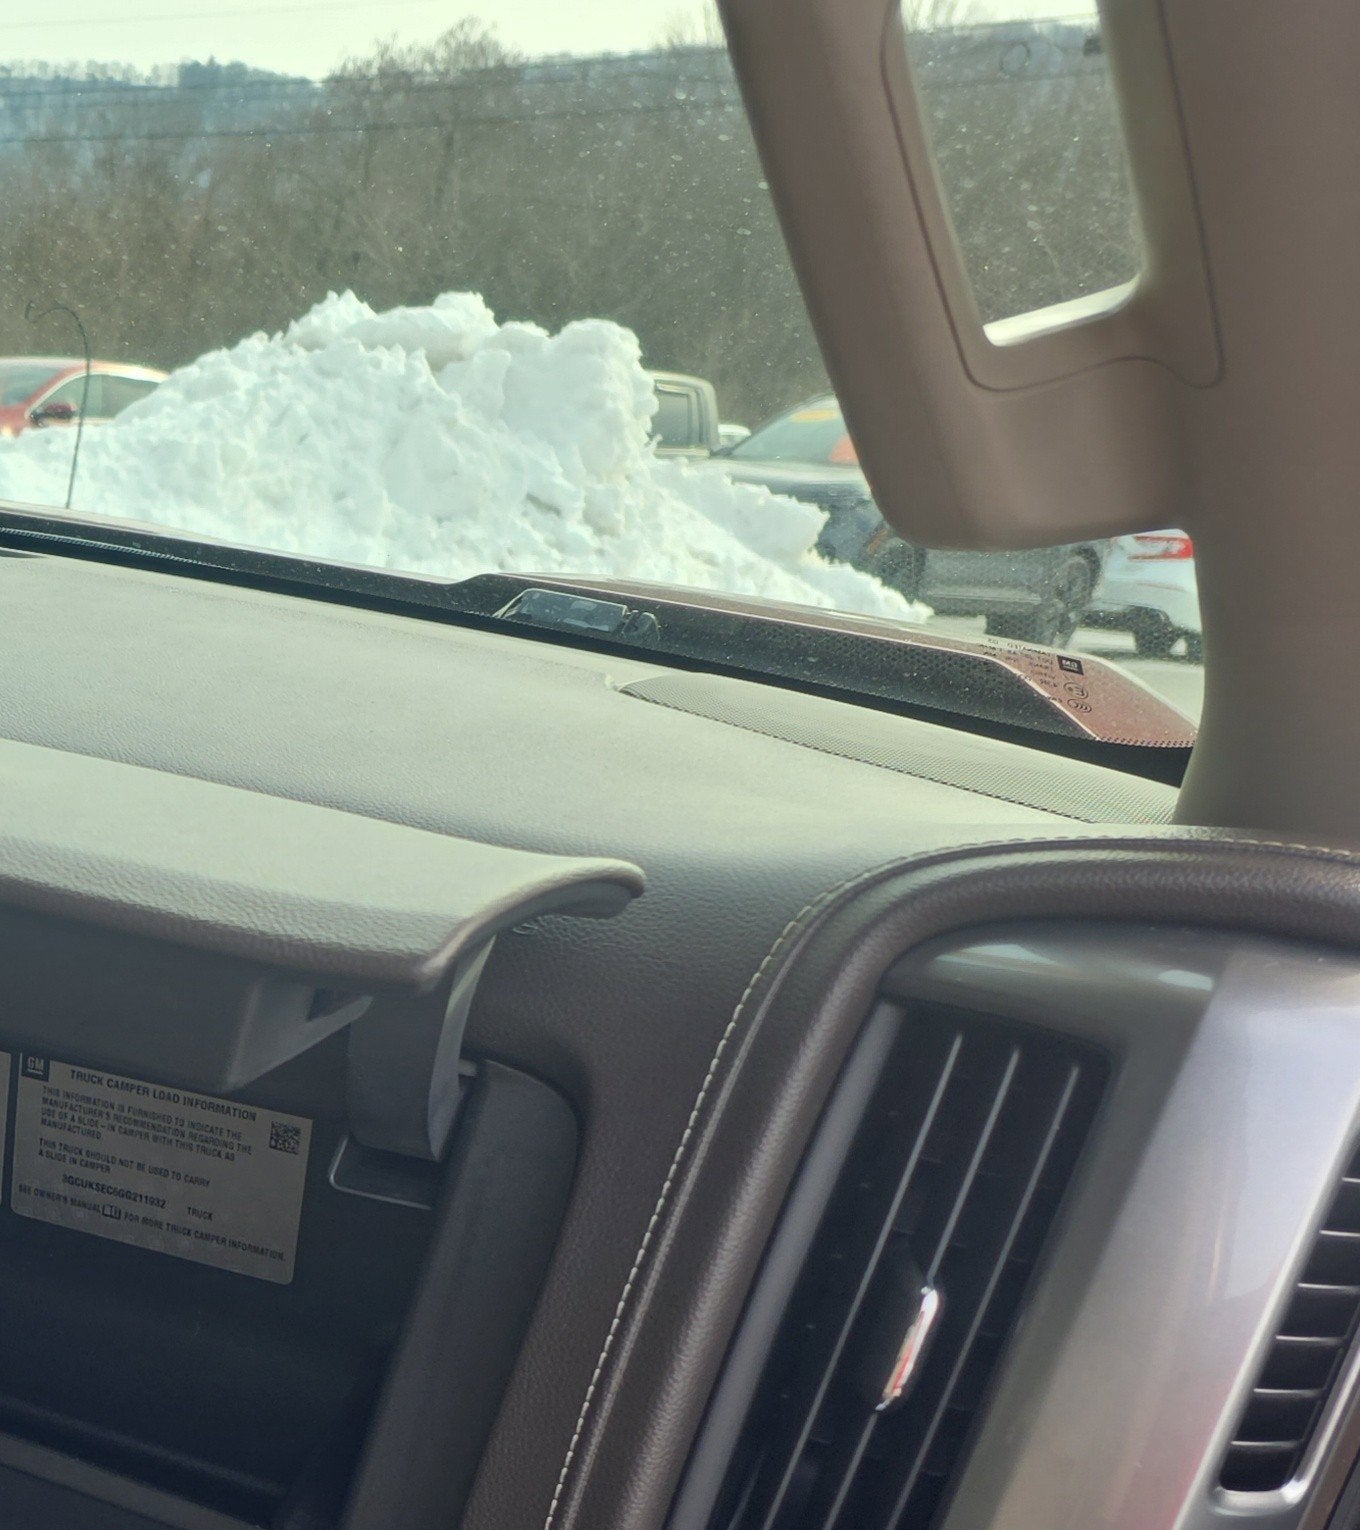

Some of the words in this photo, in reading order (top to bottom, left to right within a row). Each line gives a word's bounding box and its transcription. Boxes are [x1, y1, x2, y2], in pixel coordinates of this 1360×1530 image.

[27, 1056, 44, 1071] GM
[70, 1069, 104, 1086] TRUCK
[106, 1078, 150, 1097] CAMPER
[152, 1089, 180, 1104] LOAD
[182, 1096, 257, 1121] INFORMATION
[62, 1089, 115, 1110] INFORMATION
[187, 1120, 224, 1137] INDICATE
[226, 1129, 242, 1141] THE
[195, 1143, 222, 1159] TRUCK
[236, 1143, 253, 1155] THE
[58, 1142, 83, 1156] TRUCK
[85, 1149, 117, 1165] SHOULD
[118, 1158, 134, 1169] NOT
[148, 1165, 170, 1178] USED
[171, 1170, 182, 1182] TO
[183, 1174, 211, 1187] CARRY
[79, 1158, 111, 1173] CAMPER
[70, 1196, 101, 1213] MANUAL
[124, 1210, 140, 1223] FOR
[141, 1216, 164, 1231] MORE
[165, 1221, 193, 1237] TRUCK
[193, 1229, 227, 1247] CAMPER
[186, 1206, 215, 1222] TRUCK
